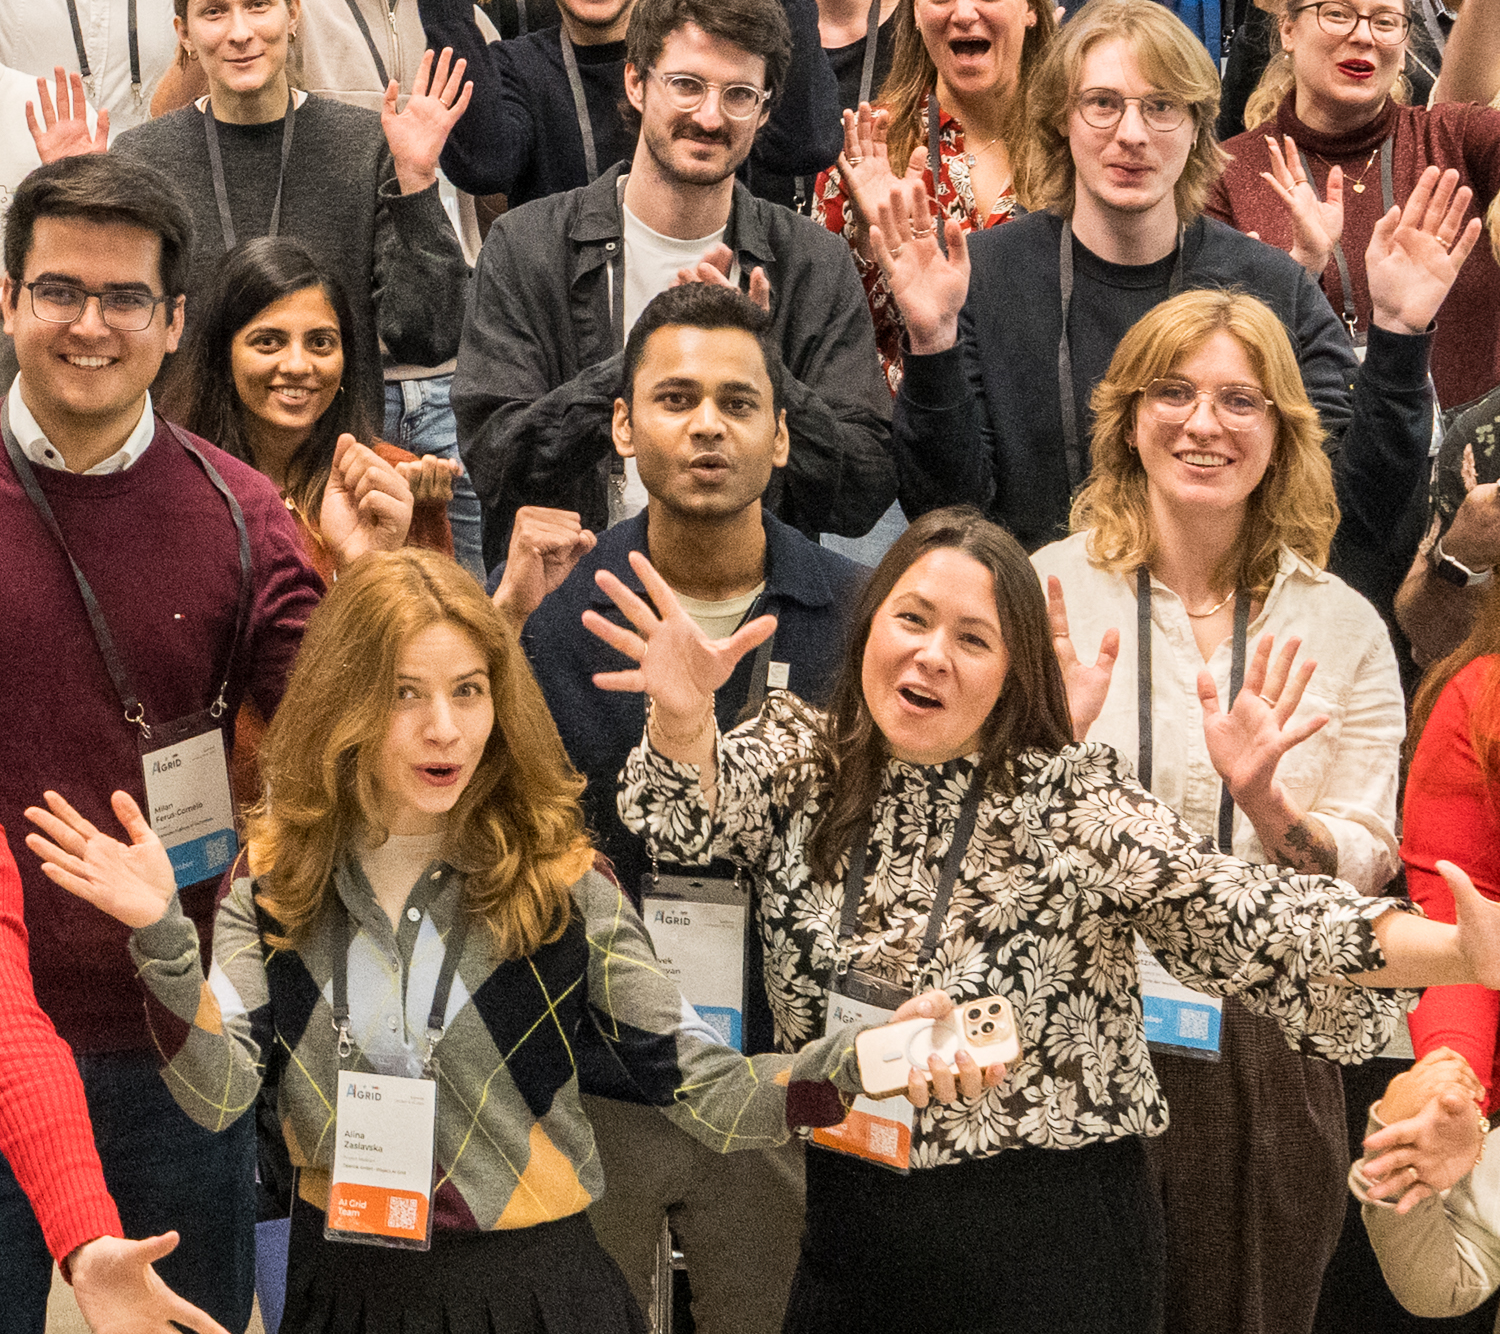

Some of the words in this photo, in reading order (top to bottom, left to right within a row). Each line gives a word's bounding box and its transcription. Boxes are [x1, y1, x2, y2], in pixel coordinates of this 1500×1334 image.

[154, 802, 174, 814] Milan
[344, 1130, 365, 1140] Alina
[344, 1140, 384, 1153] Zaslavska
[338, 1198, 347, 1206] AI
[348, 1198, 367, 1209] Grid
[338, 1206, 361, 1218] Team
